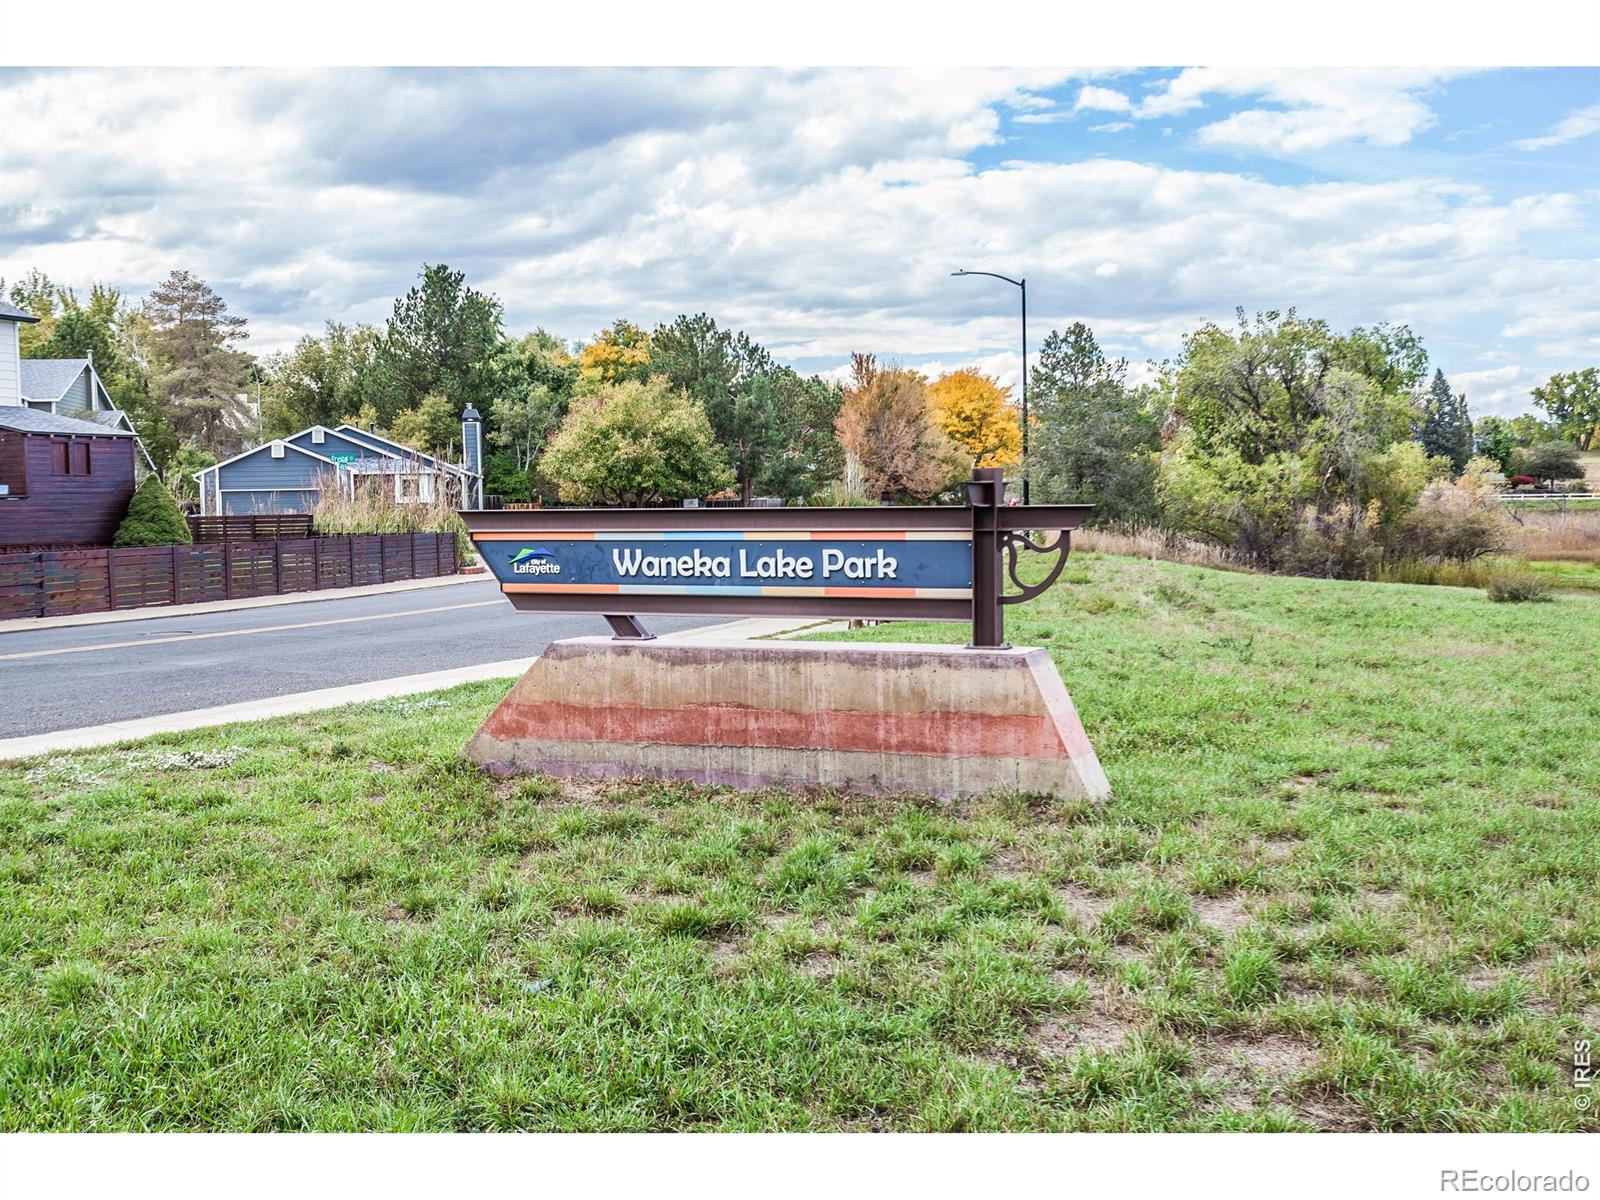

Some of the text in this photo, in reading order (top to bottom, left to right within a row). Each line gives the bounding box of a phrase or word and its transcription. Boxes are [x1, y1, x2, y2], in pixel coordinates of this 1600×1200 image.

[513, 562, 561, 576] Lafayette
[612, 548, 897, 579] Waneka Lake Park
